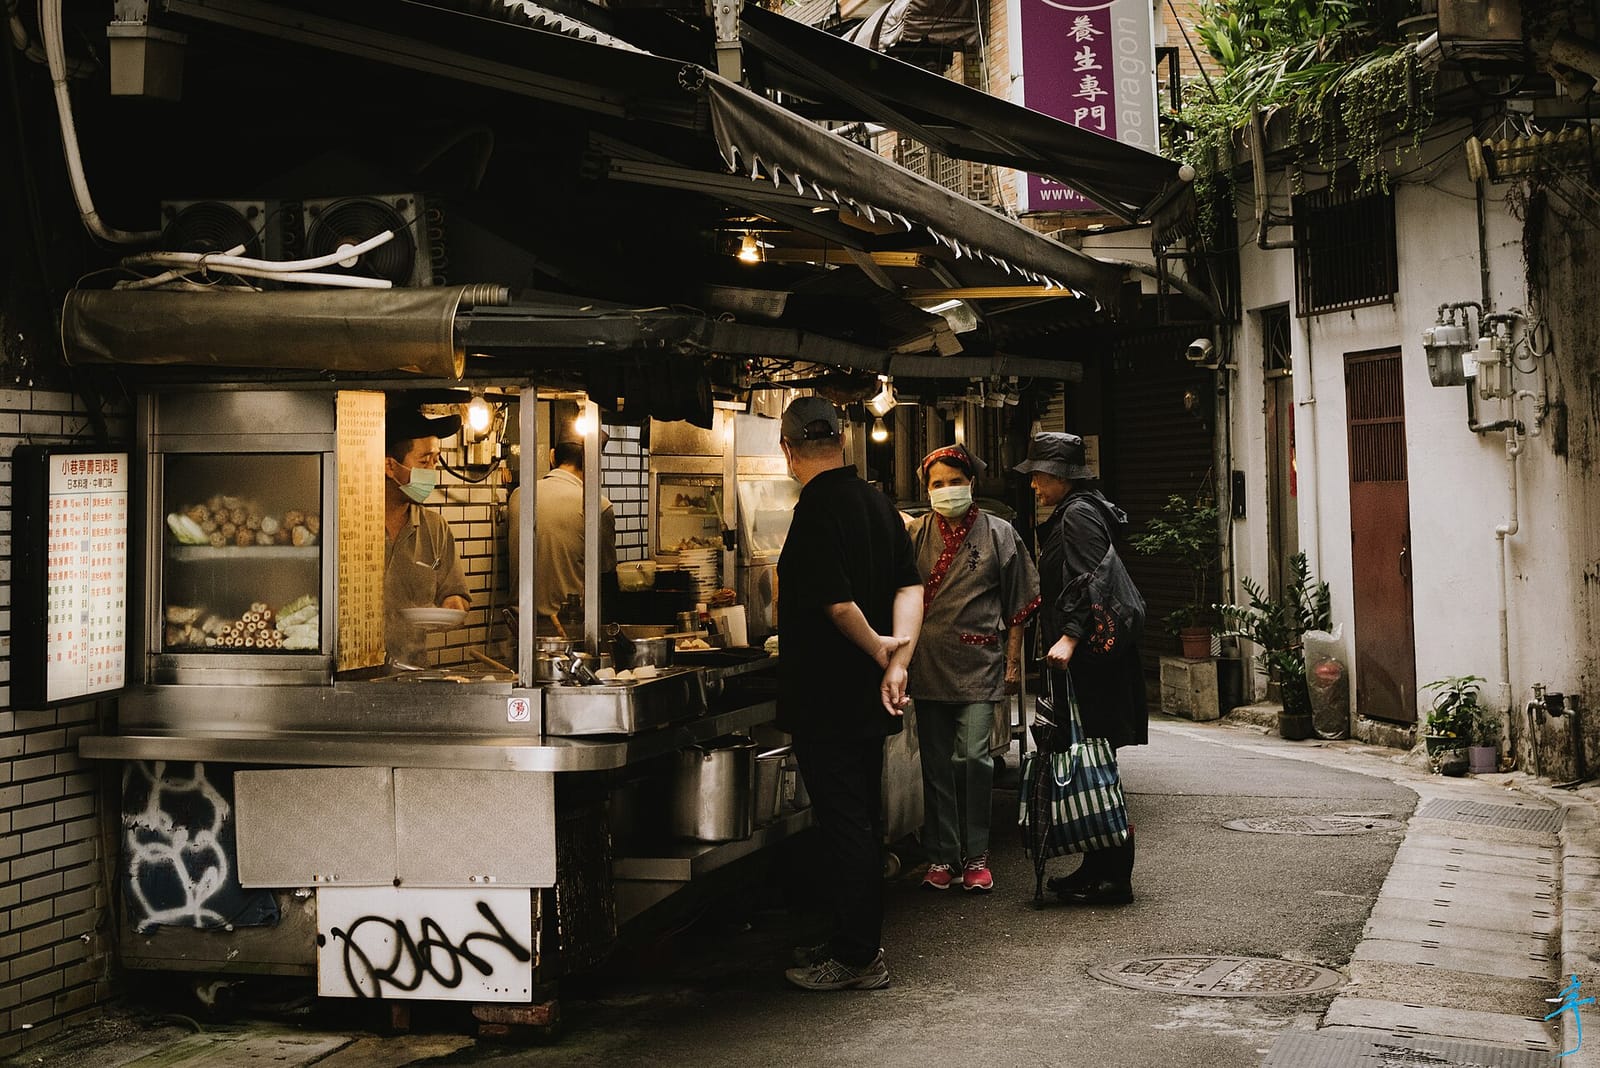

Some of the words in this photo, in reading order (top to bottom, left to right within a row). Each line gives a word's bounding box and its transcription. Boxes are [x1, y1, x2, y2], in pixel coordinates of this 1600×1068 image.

[1066, 15, 1109, 132] 養生專門
[1117, 17, 1149, 147] paragon
